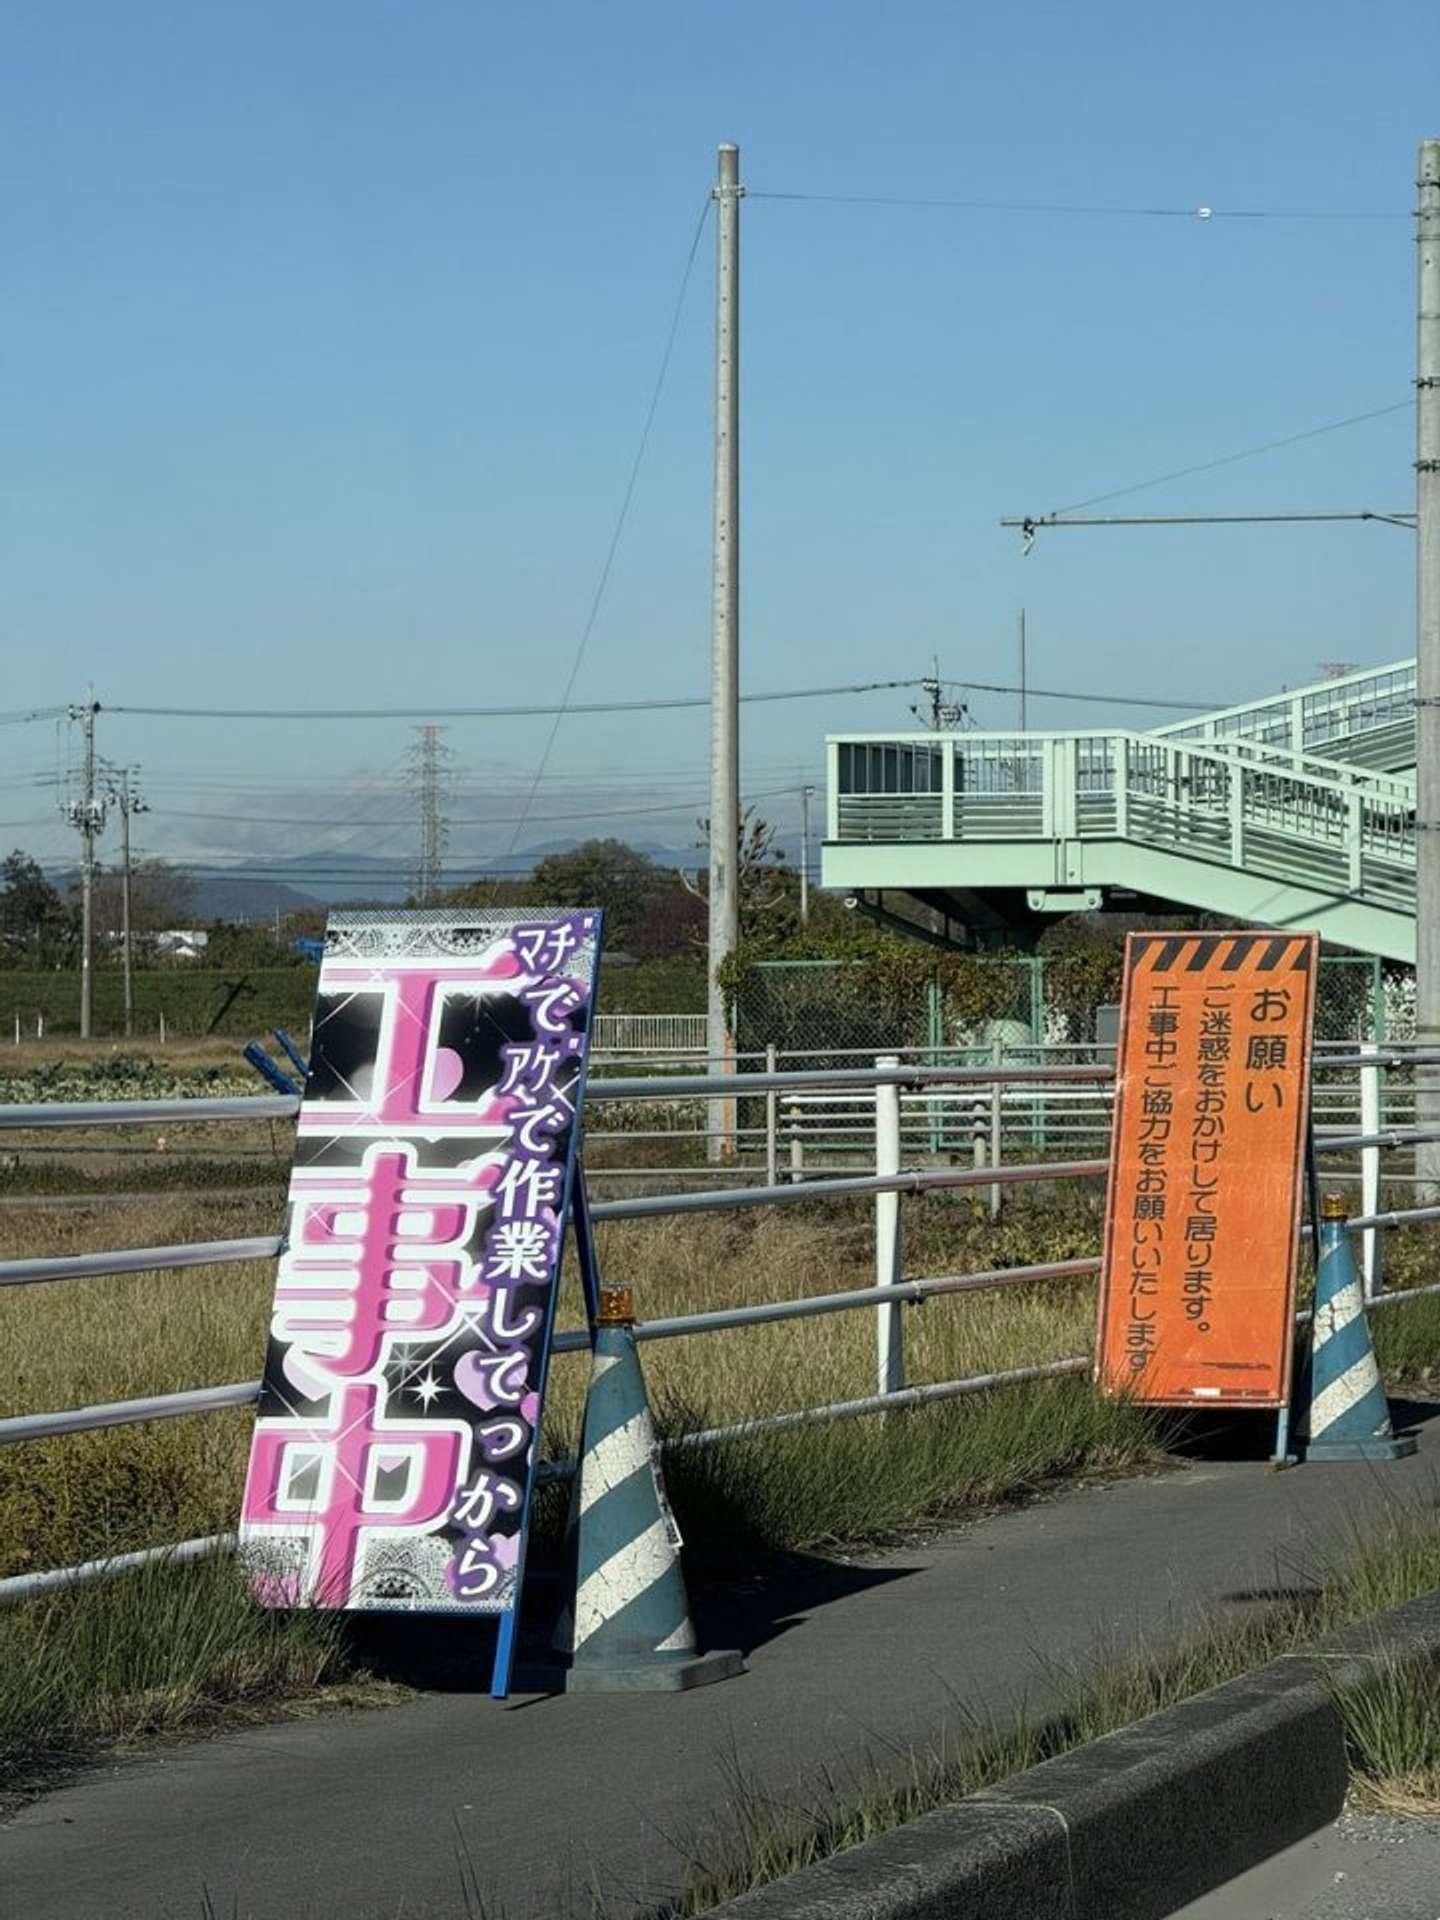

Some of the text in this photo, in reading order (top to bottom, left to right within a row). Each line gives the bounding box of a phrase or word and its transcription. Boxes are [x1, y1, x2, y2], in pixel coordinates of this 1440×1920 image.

[1125, 985, 1181, 1372] 工事中ご協力をお願いいたします
[1181, 984, 1236, 1333] ご迷惑をおかけして居ります。
[1245, 988, 1292, 1114] お願い
[242, 942, 528, 1609] 工事中
